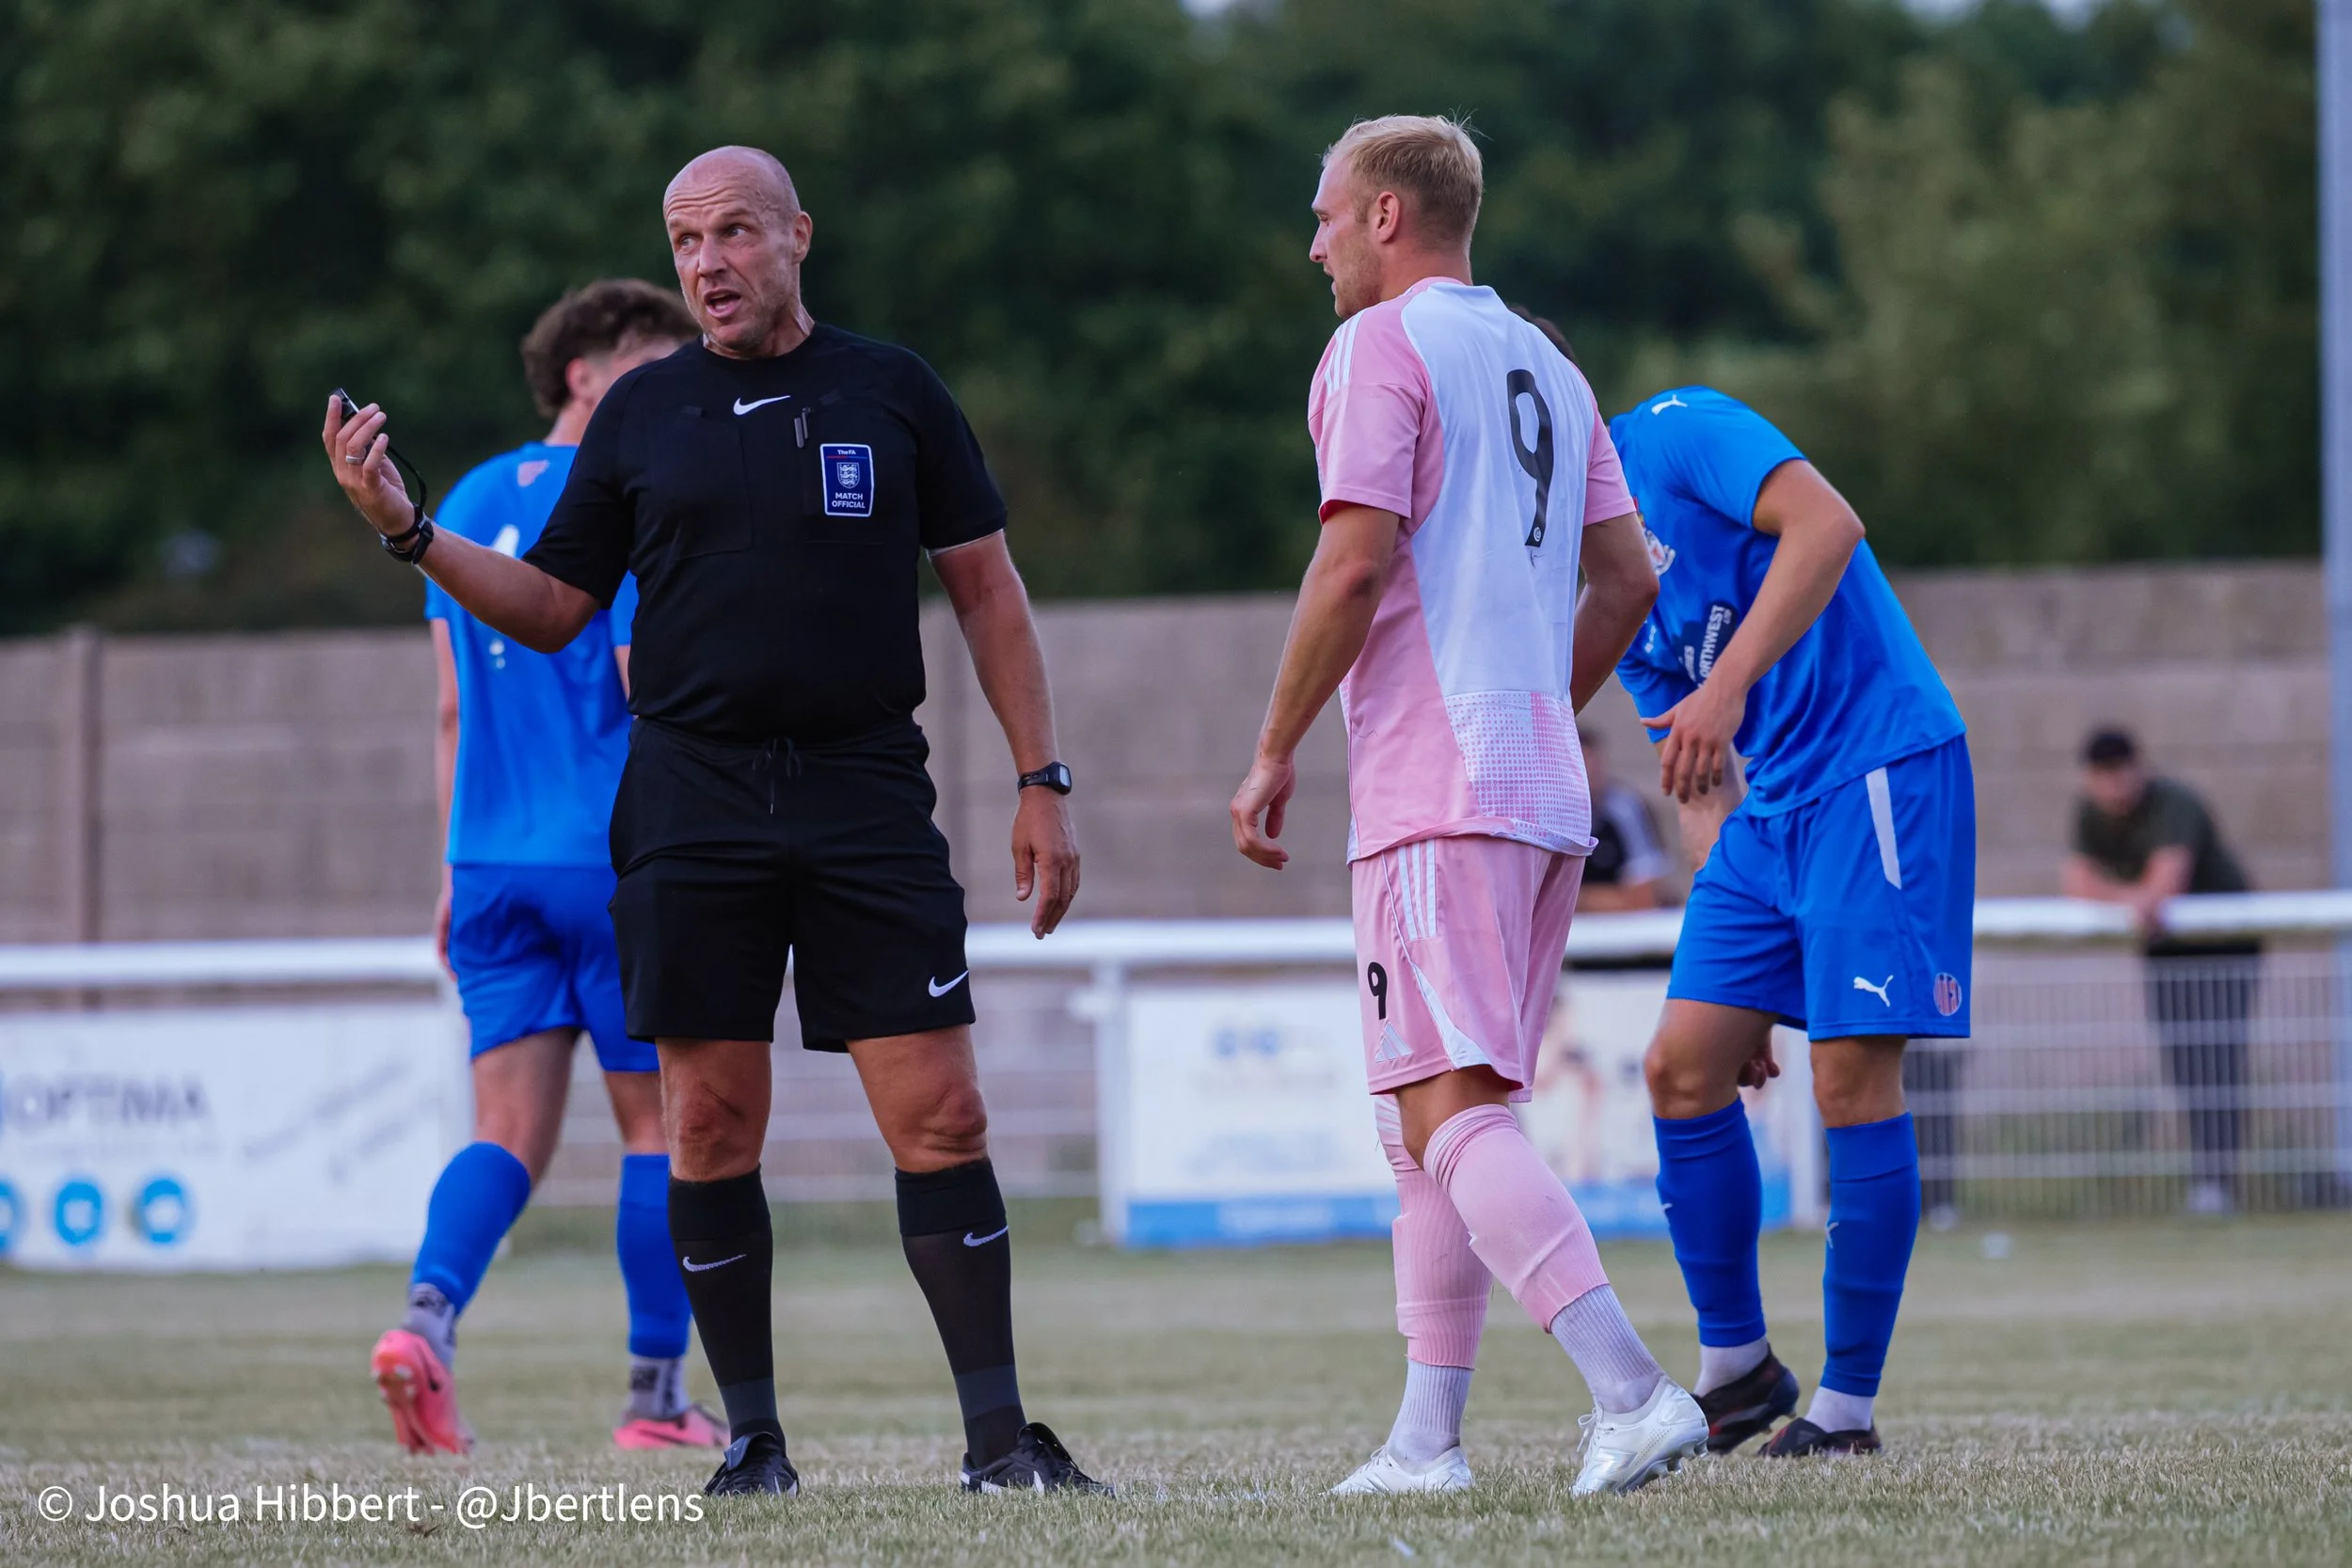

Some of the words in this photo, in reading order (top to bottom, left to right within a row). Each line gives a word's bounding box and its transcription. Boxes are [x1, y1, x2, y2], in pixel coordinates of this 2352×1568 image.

[1506, 369, 1553, 547] 9
[831, 499, 866, 509] OFFICIAL
[834, 492, 864, 500] MATCH
[1697, 605, 1724, 689] ORTHWEST
[1367, 961, 1388, 1020] 9
